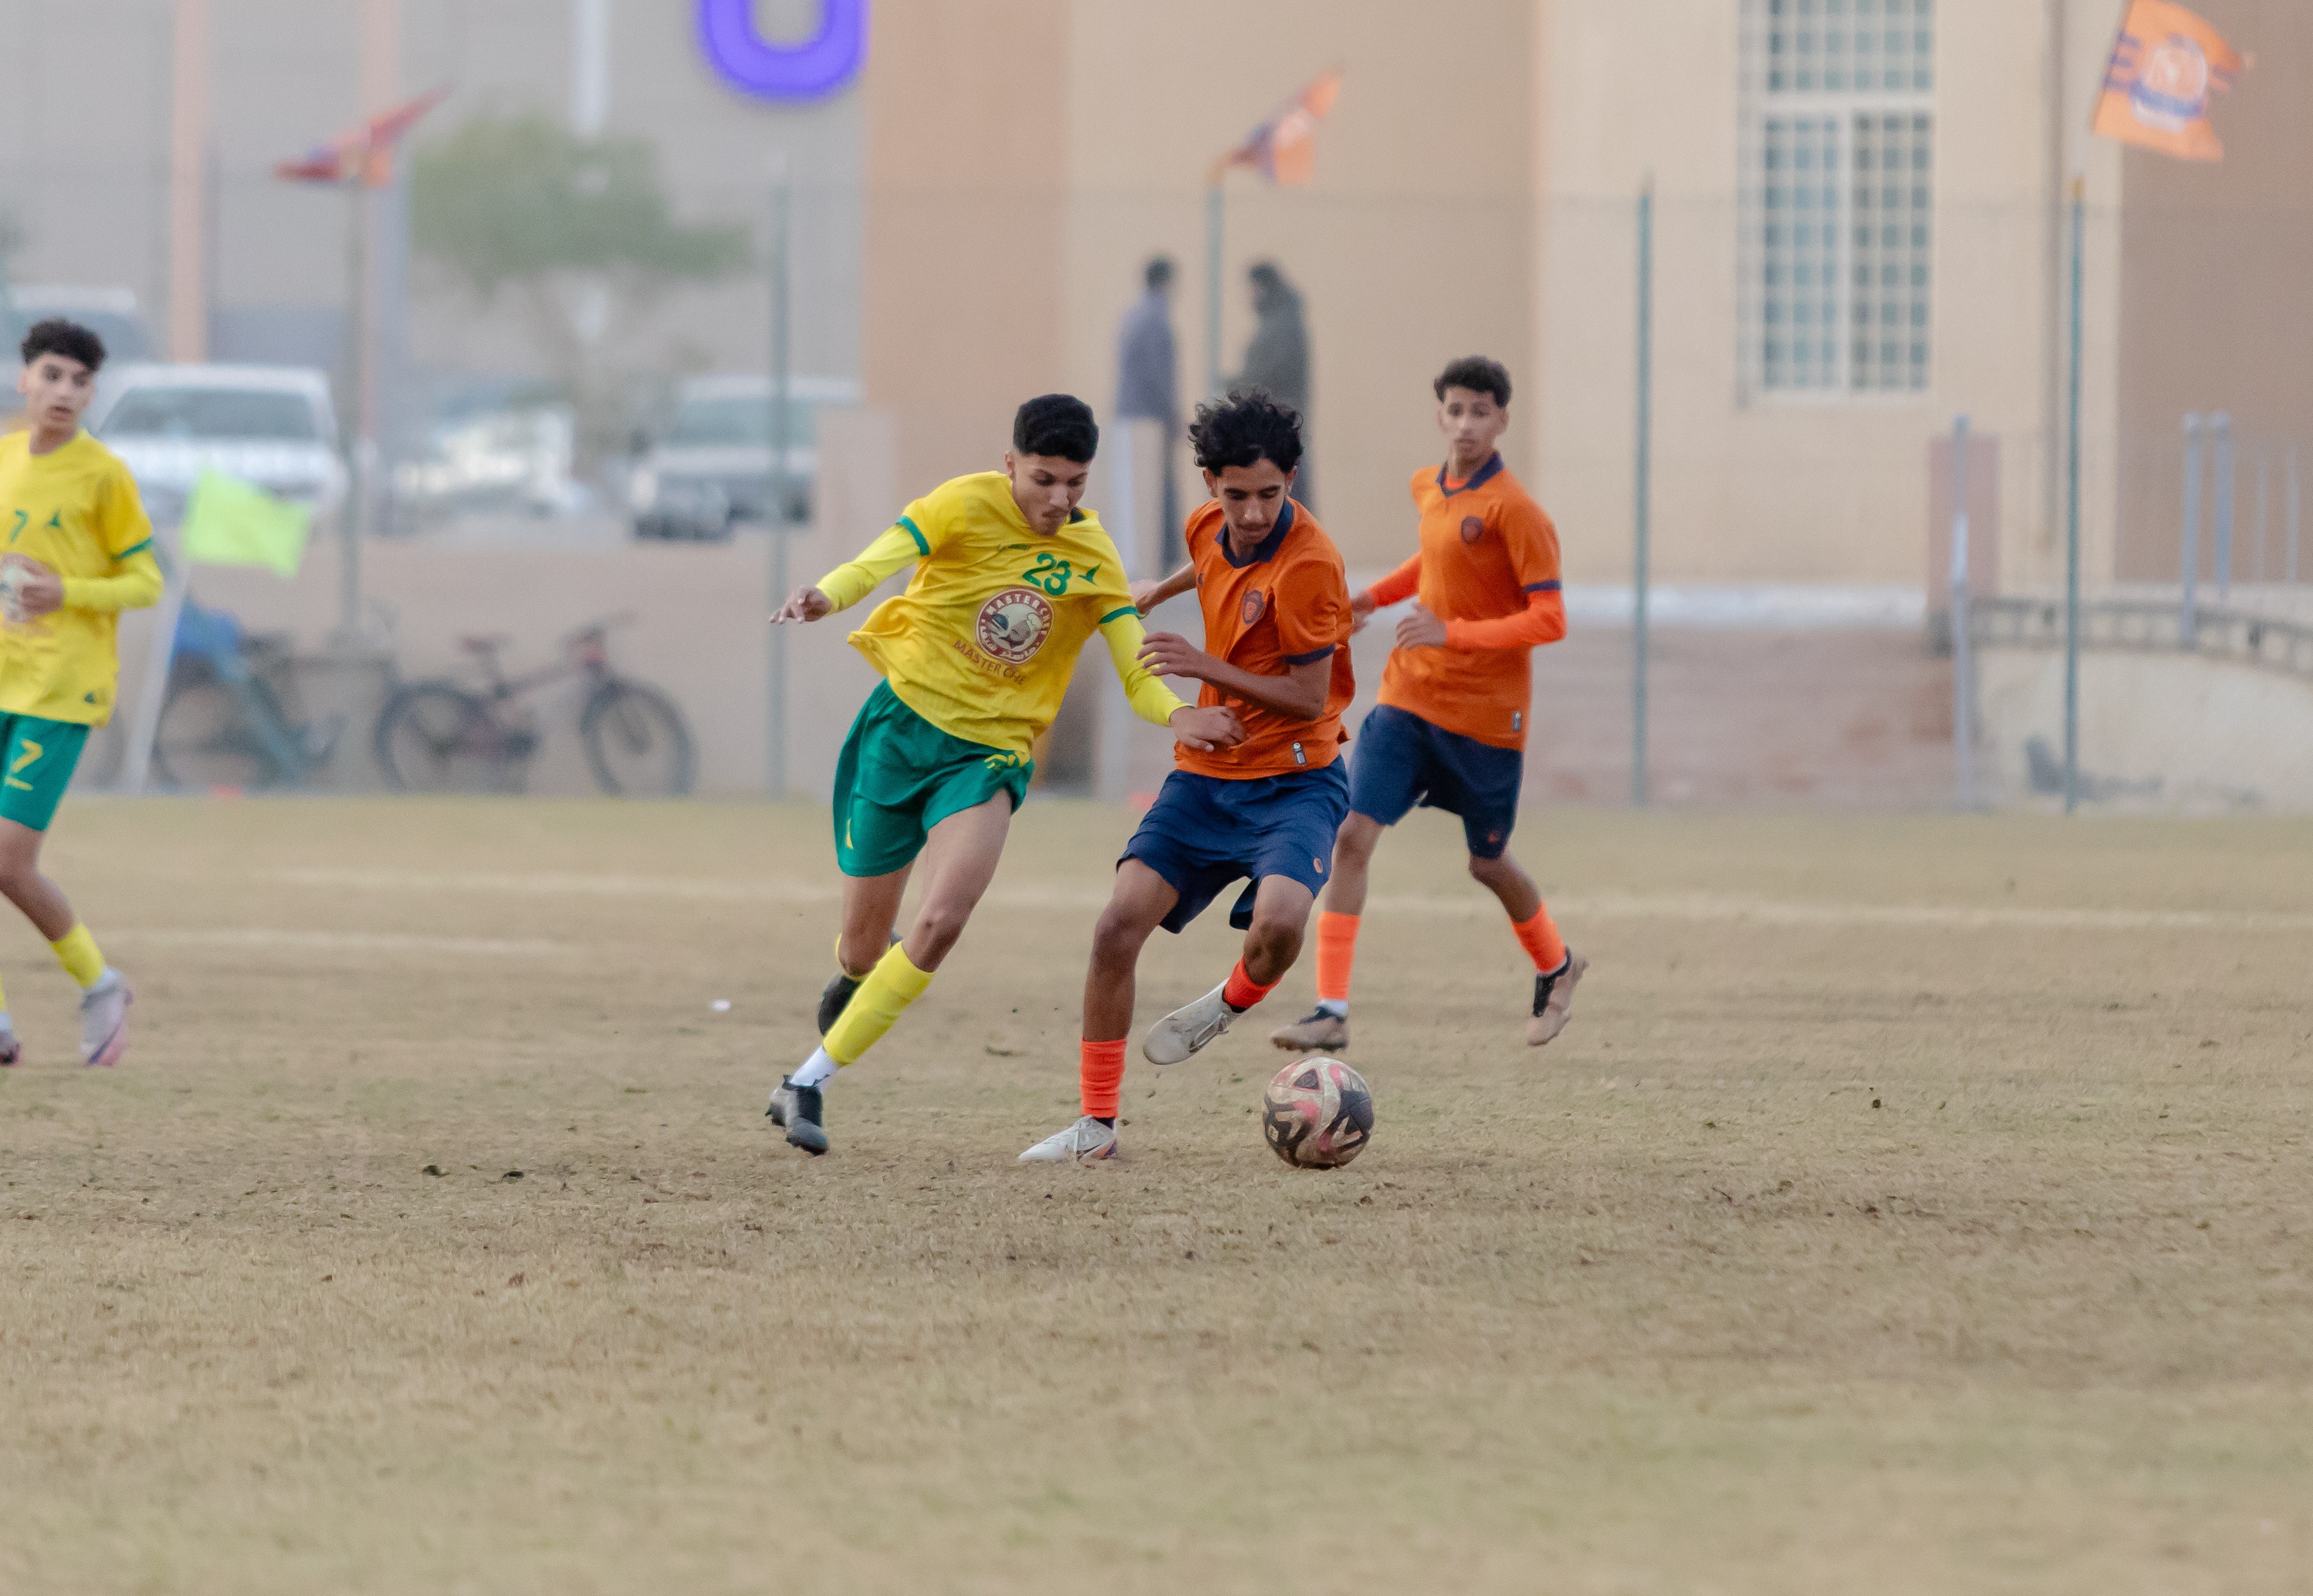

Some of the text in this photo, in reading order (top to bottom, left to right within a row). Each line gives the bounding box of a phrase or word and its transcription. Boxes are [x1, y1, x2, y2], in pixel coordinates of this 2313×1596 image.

[1021, 552, 1072, 596] 23
[986, 593, 1040, 615] MASTER
[953, 639, 1002, 675] MASTER
